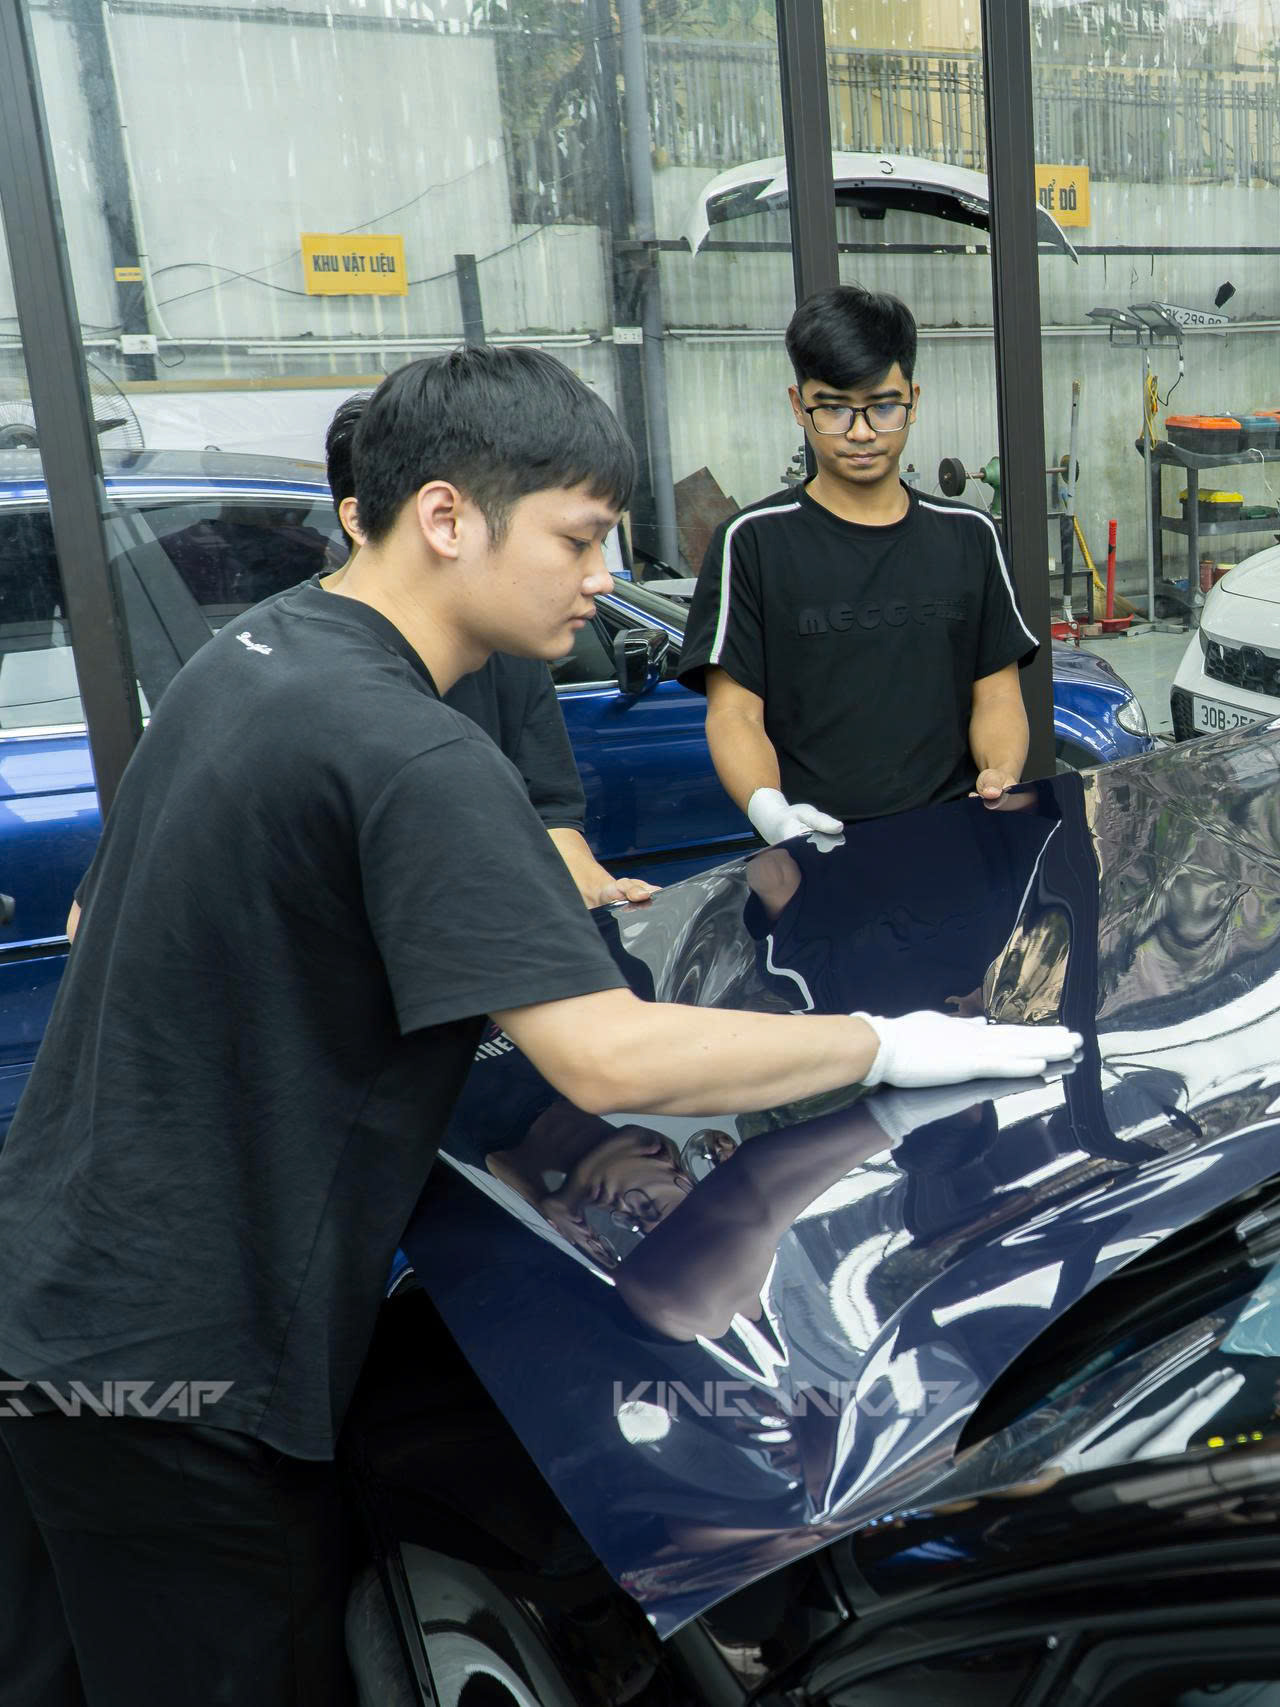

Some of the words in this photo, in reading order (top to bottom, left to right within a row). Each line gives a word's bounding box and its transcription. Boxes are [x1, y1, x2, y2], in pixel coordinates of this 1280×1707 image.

[312, 254, 339, 272] KHU
[343, 252, 366, 276] VẬT
[369, 252, 396, 277] LIỆU
